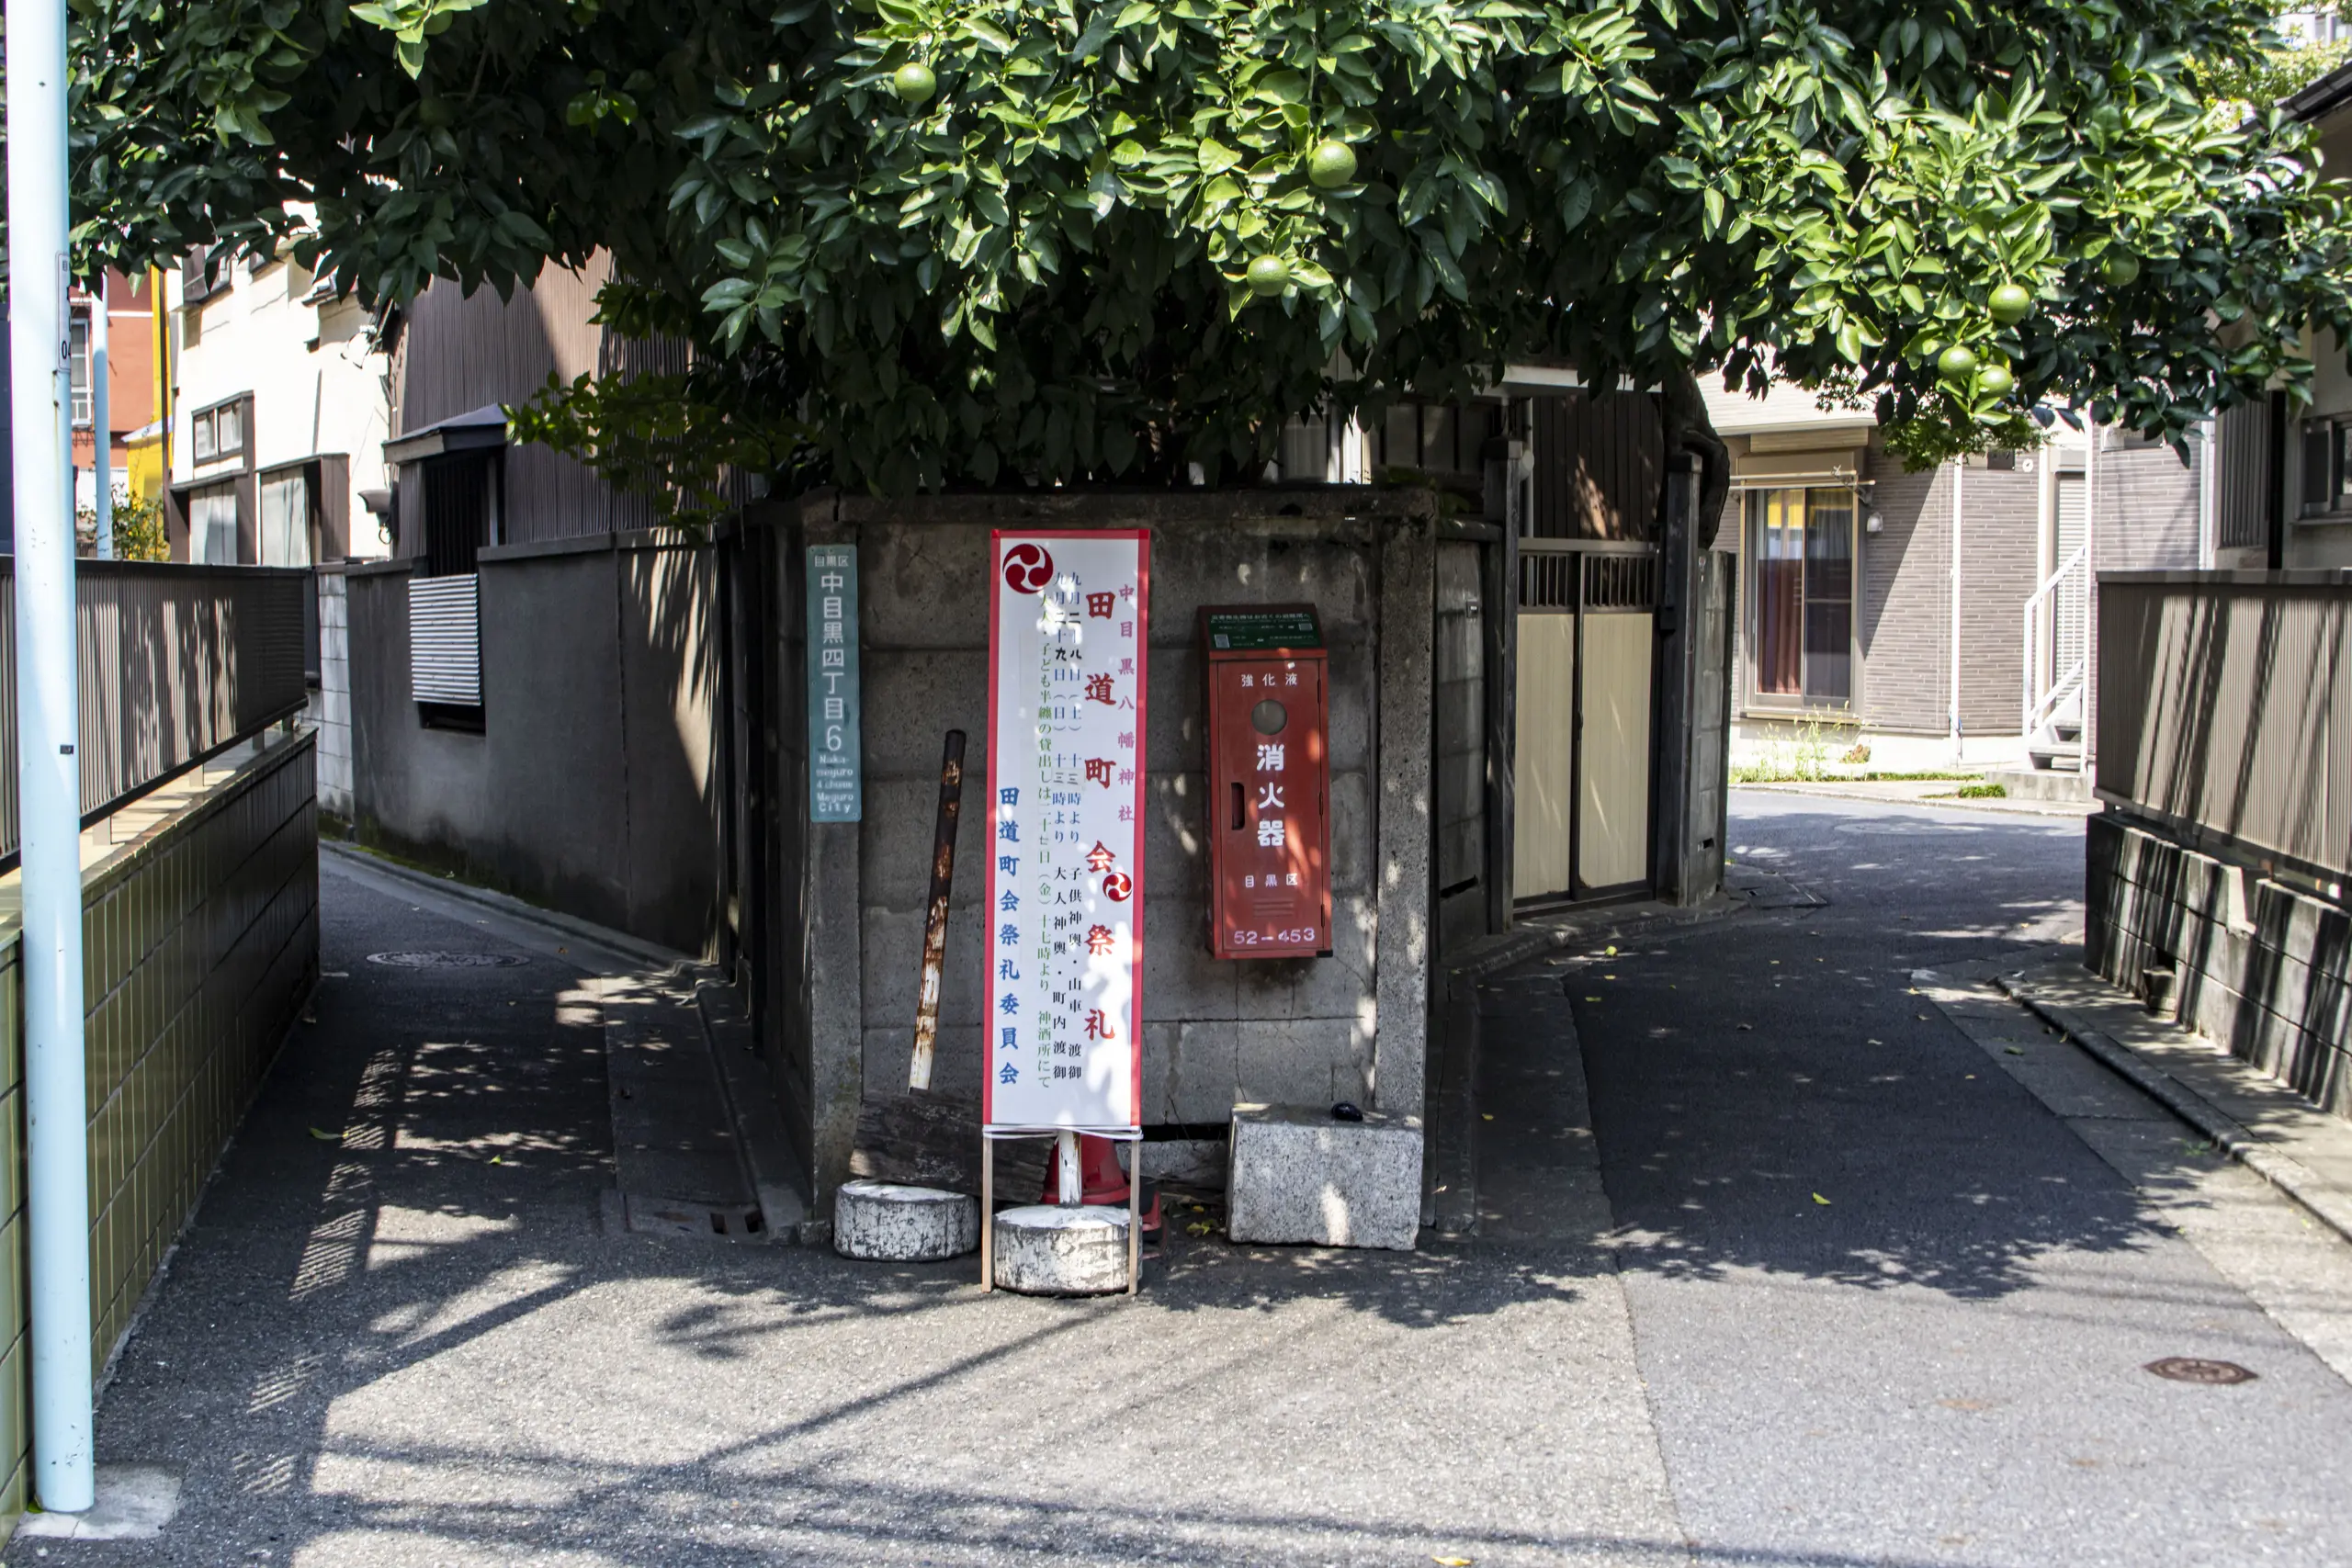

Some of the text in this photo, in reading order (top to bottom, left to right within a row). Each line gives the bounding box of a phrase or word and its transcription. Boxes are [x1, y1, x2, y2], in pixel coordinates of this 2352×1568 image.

[814, 555, 849, 568] 目黒区
[820, 571, 844, 751] 中目黒四丁目6
[1240, 672, 1297, 687] 強化液
[1118, 584, 1135, 822] 中目黒八幡神社
[817, 792, 854, 803] Meguro
[1257, 744, 1284, 847] 消火器
[819, 802, 851, 814] City
[1084, 592, 1117, 1041] 田道町会祭礼
[1245, 873, 1298, 888] 目黒区
[998, 786, 1021, 1085] 田道町会祭礼委員会
[1234, 927, 1315, 944] 52-453
